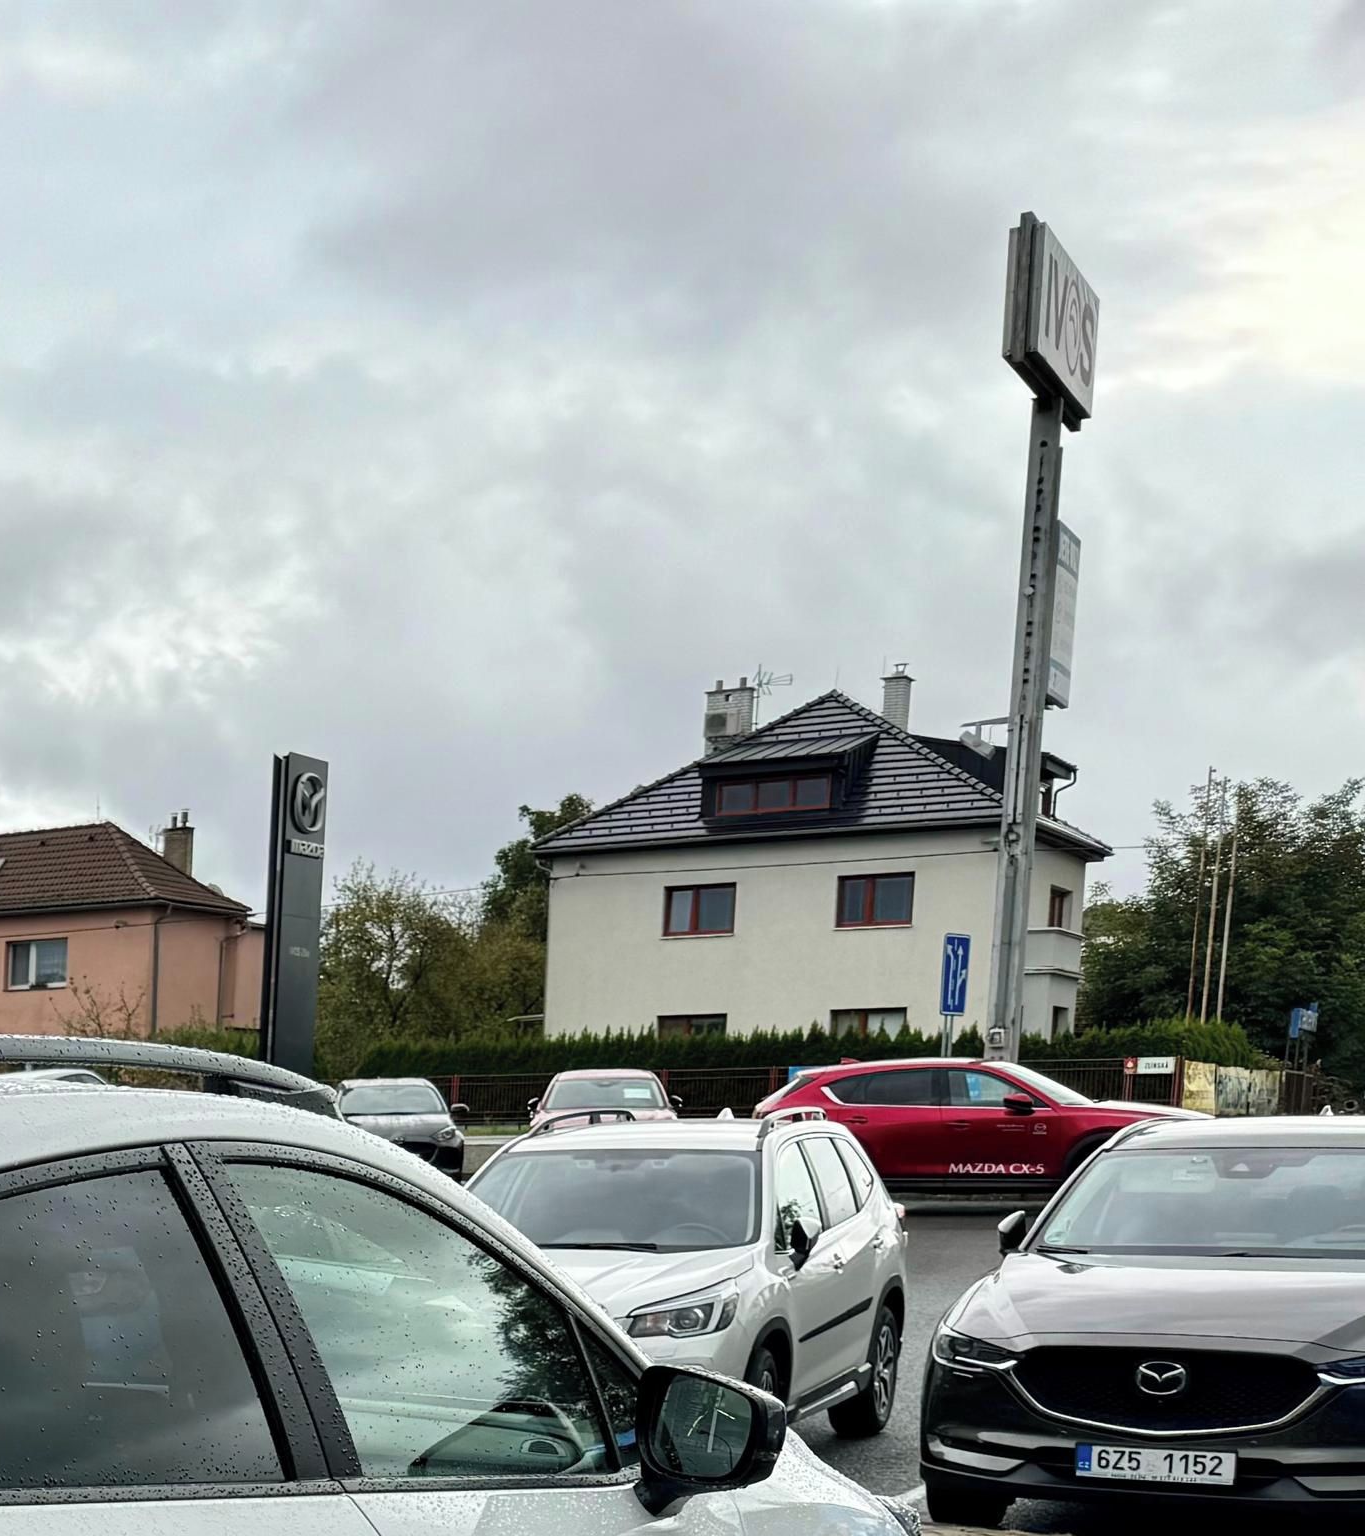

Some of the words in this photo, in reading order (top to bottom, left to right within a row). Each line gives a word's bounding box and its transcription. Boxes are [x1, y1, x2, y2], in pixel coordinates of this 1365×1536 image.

[949, 1163, 1006, 1175] MAZDA
[1009, 1163, 1045, 1175] CX-5
[1097, 1449, 1142, 1472] 6Z5
[1163, 1452, 1224, 1477] 1152
